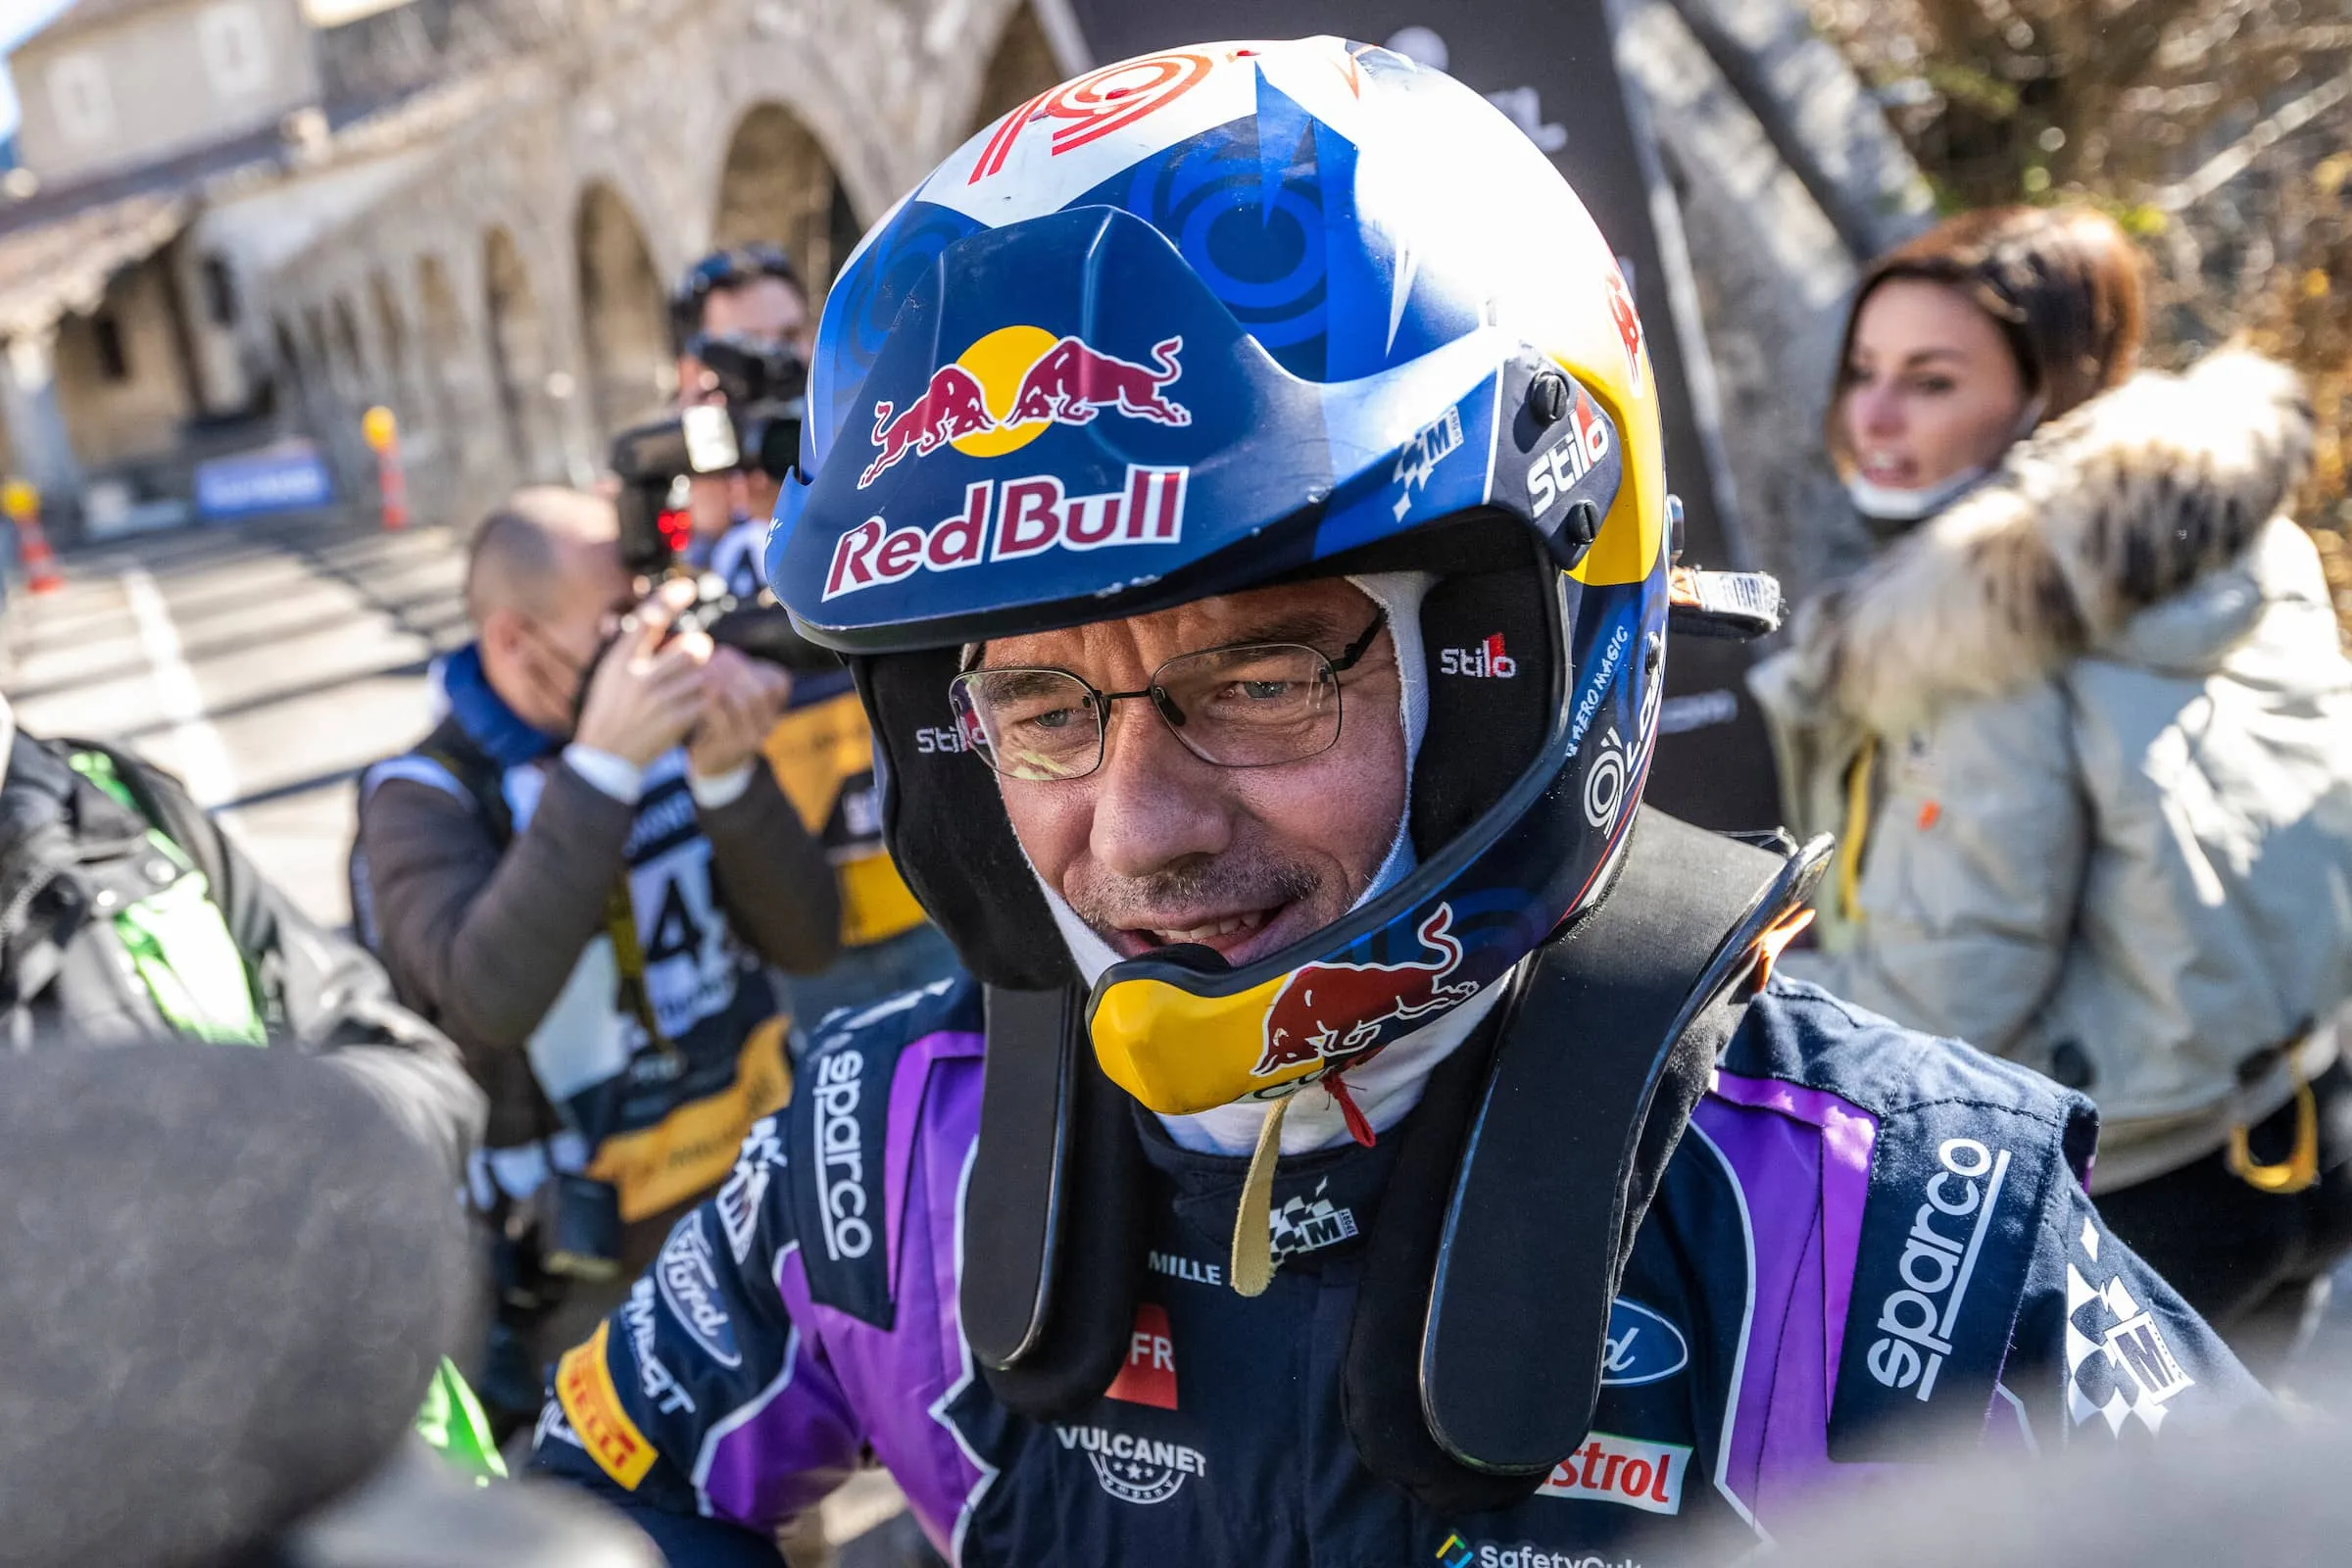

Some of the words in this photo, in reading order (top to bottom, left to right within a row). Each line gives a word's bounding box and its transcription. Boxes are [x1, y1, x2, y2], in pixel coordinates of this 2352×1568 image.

[1526, 400, 1609, 519] Stilo
[823, 481, 992, 600] Red
[992, 466, 1186, 561] Bull
[1440, 639, 1517, 678] Stilo
[1571, 687, 1599, 742] AERO
[1592, 625, 1629, 691] MAGIC
[813, 1050, 873, 1259] sparco
[1149, 1250, 1222, 1286] MILLE
[1867, 1138, 1999, 1393] sparco
[1054, 1425, 1206, 1478] VULCANET
[1543, 1442, 1671, 1503] strol
